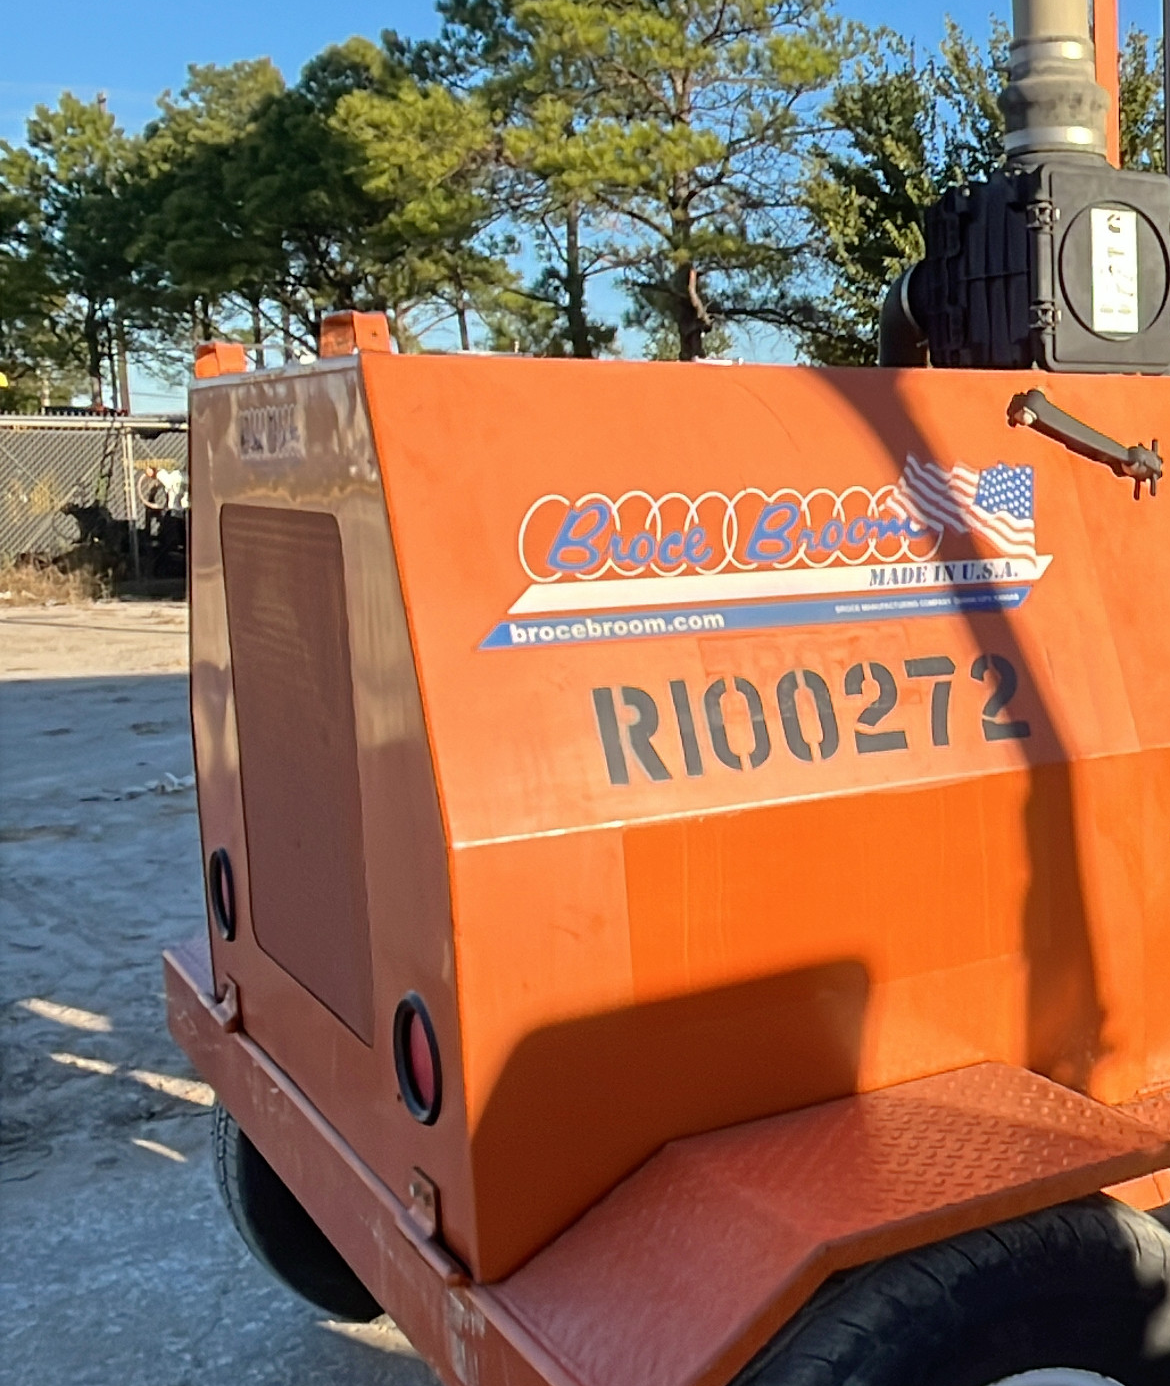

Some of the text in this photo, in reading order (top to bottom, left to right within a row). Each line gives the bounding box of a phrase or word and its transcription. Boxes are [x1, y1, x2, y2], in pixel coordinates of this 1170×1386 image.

[546, 502, 713, 572] Broce
[869, 561, 1019, 587] MADE IN U.S.A.
[509, 612, 726, 645] brocebroom.com
